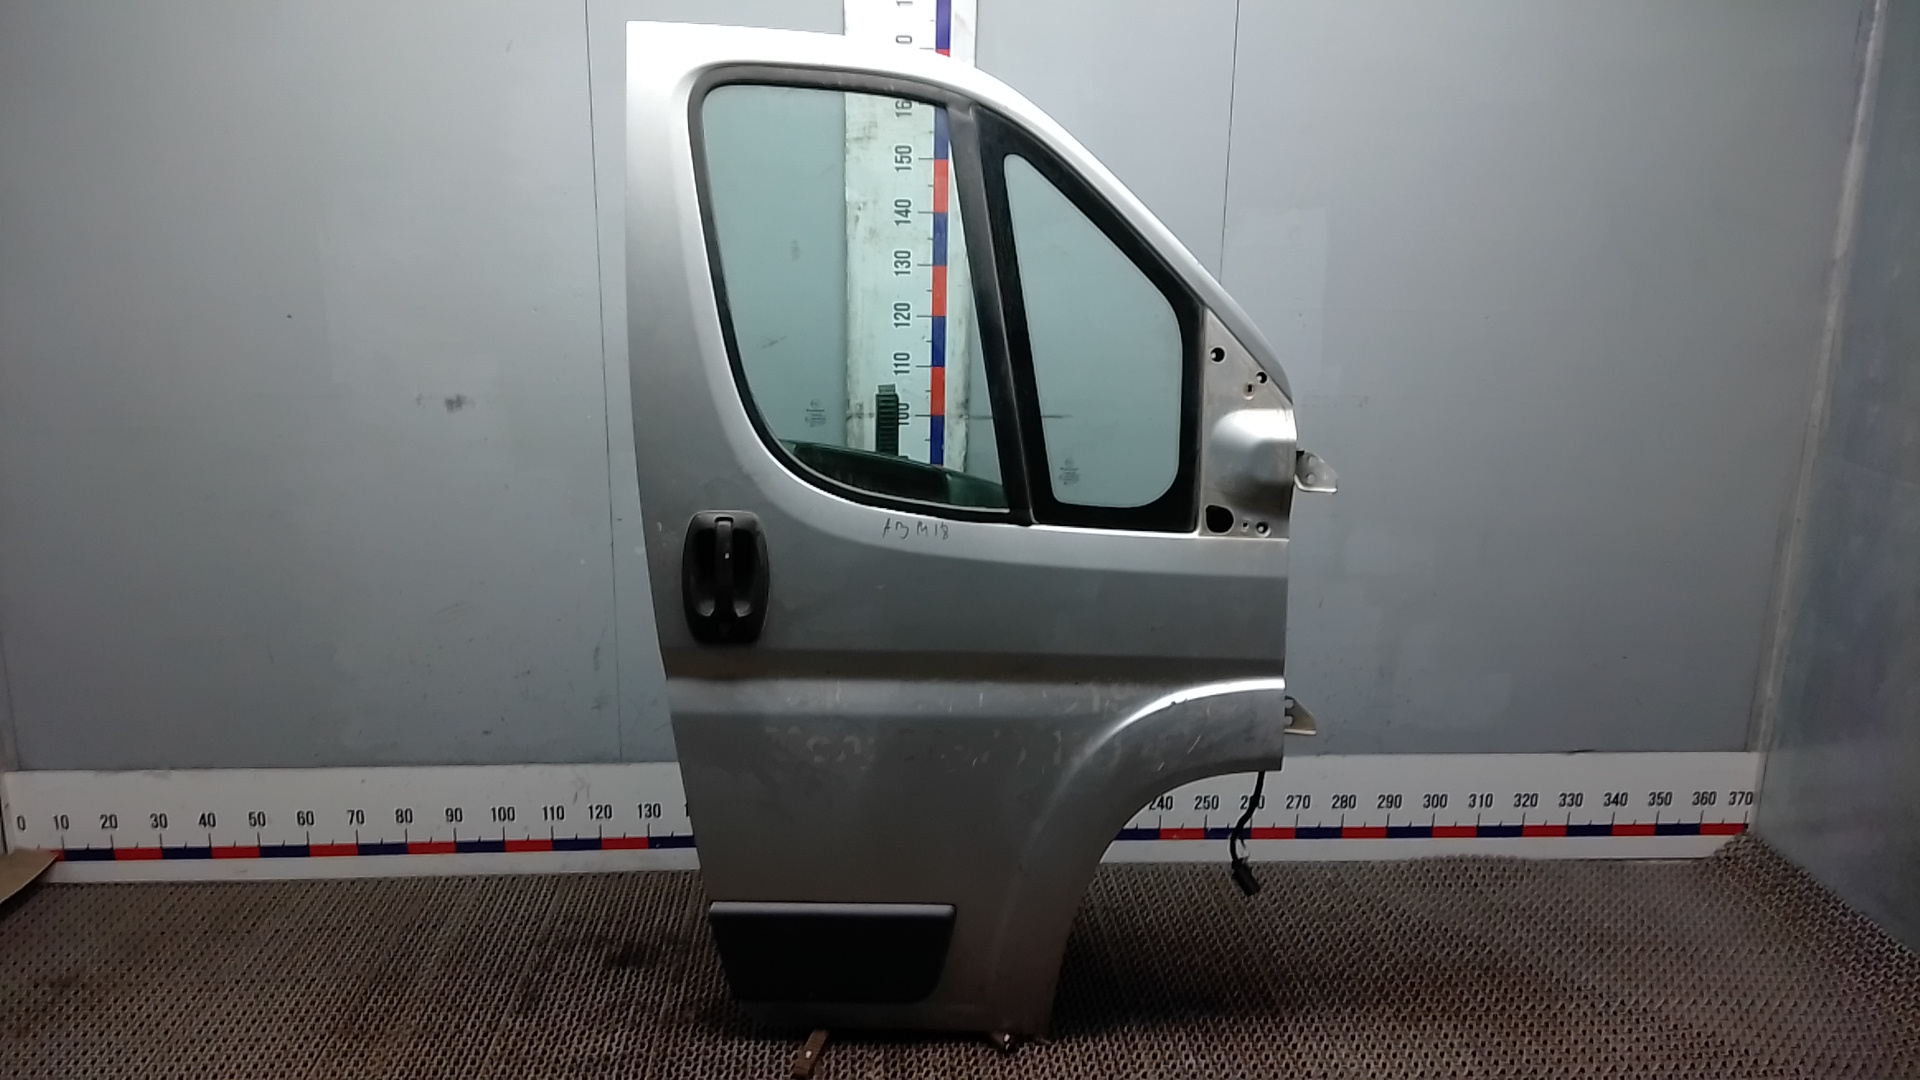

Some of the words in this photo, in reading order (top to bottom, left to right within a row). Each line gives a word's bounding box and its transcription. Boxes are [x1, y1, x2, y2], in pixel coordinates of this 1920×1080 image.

[896, 100, 912, 118] 16
[895, 145, 912, 172] 150
[894, 199, 912, 226] 140
[894, 250, 911, 276] 130
[894, 302, 911, 328] 120
[893, 352, 910, 376] 110
[1194, 795, 1220, 810] 250
[1286, 794, 1311, 810] 270
[1331, 794, 1357, 809] 280
[1377, 793, 1403, 809] 290
[1422, 793, 1448, 808] 300
[1468, 793, 1493, 808] 310
[1513, 792, 1539, 808] 320
[1558, 792, 1584, 807] 330
[1603, 792, 1629, 807] 340
[1647, 791, 1673, 807] 350
[1692, 791, 1717, 806] 360
[1728, 791, 1754, 806] 370
[248, 811, 266, 827] 50
[297, 810, 315, 826] 60
[347, 809, 365, 825] 70
[395, 808, 413, 824] 80
[445, 807, 463, 823] 90
[491, 806, 516, 822] 100
[542, 805, 565, 821] 110
[588, 804, 612, 820] 120
[637, 803, 662, 819] 130
[17, 815, 26, 831] 0
[53, 814, 70, 831] 10
[100, 813, 118, 829] 20
[149, 813, 168, 829] 30
[198, 812, 216, 828] 40
